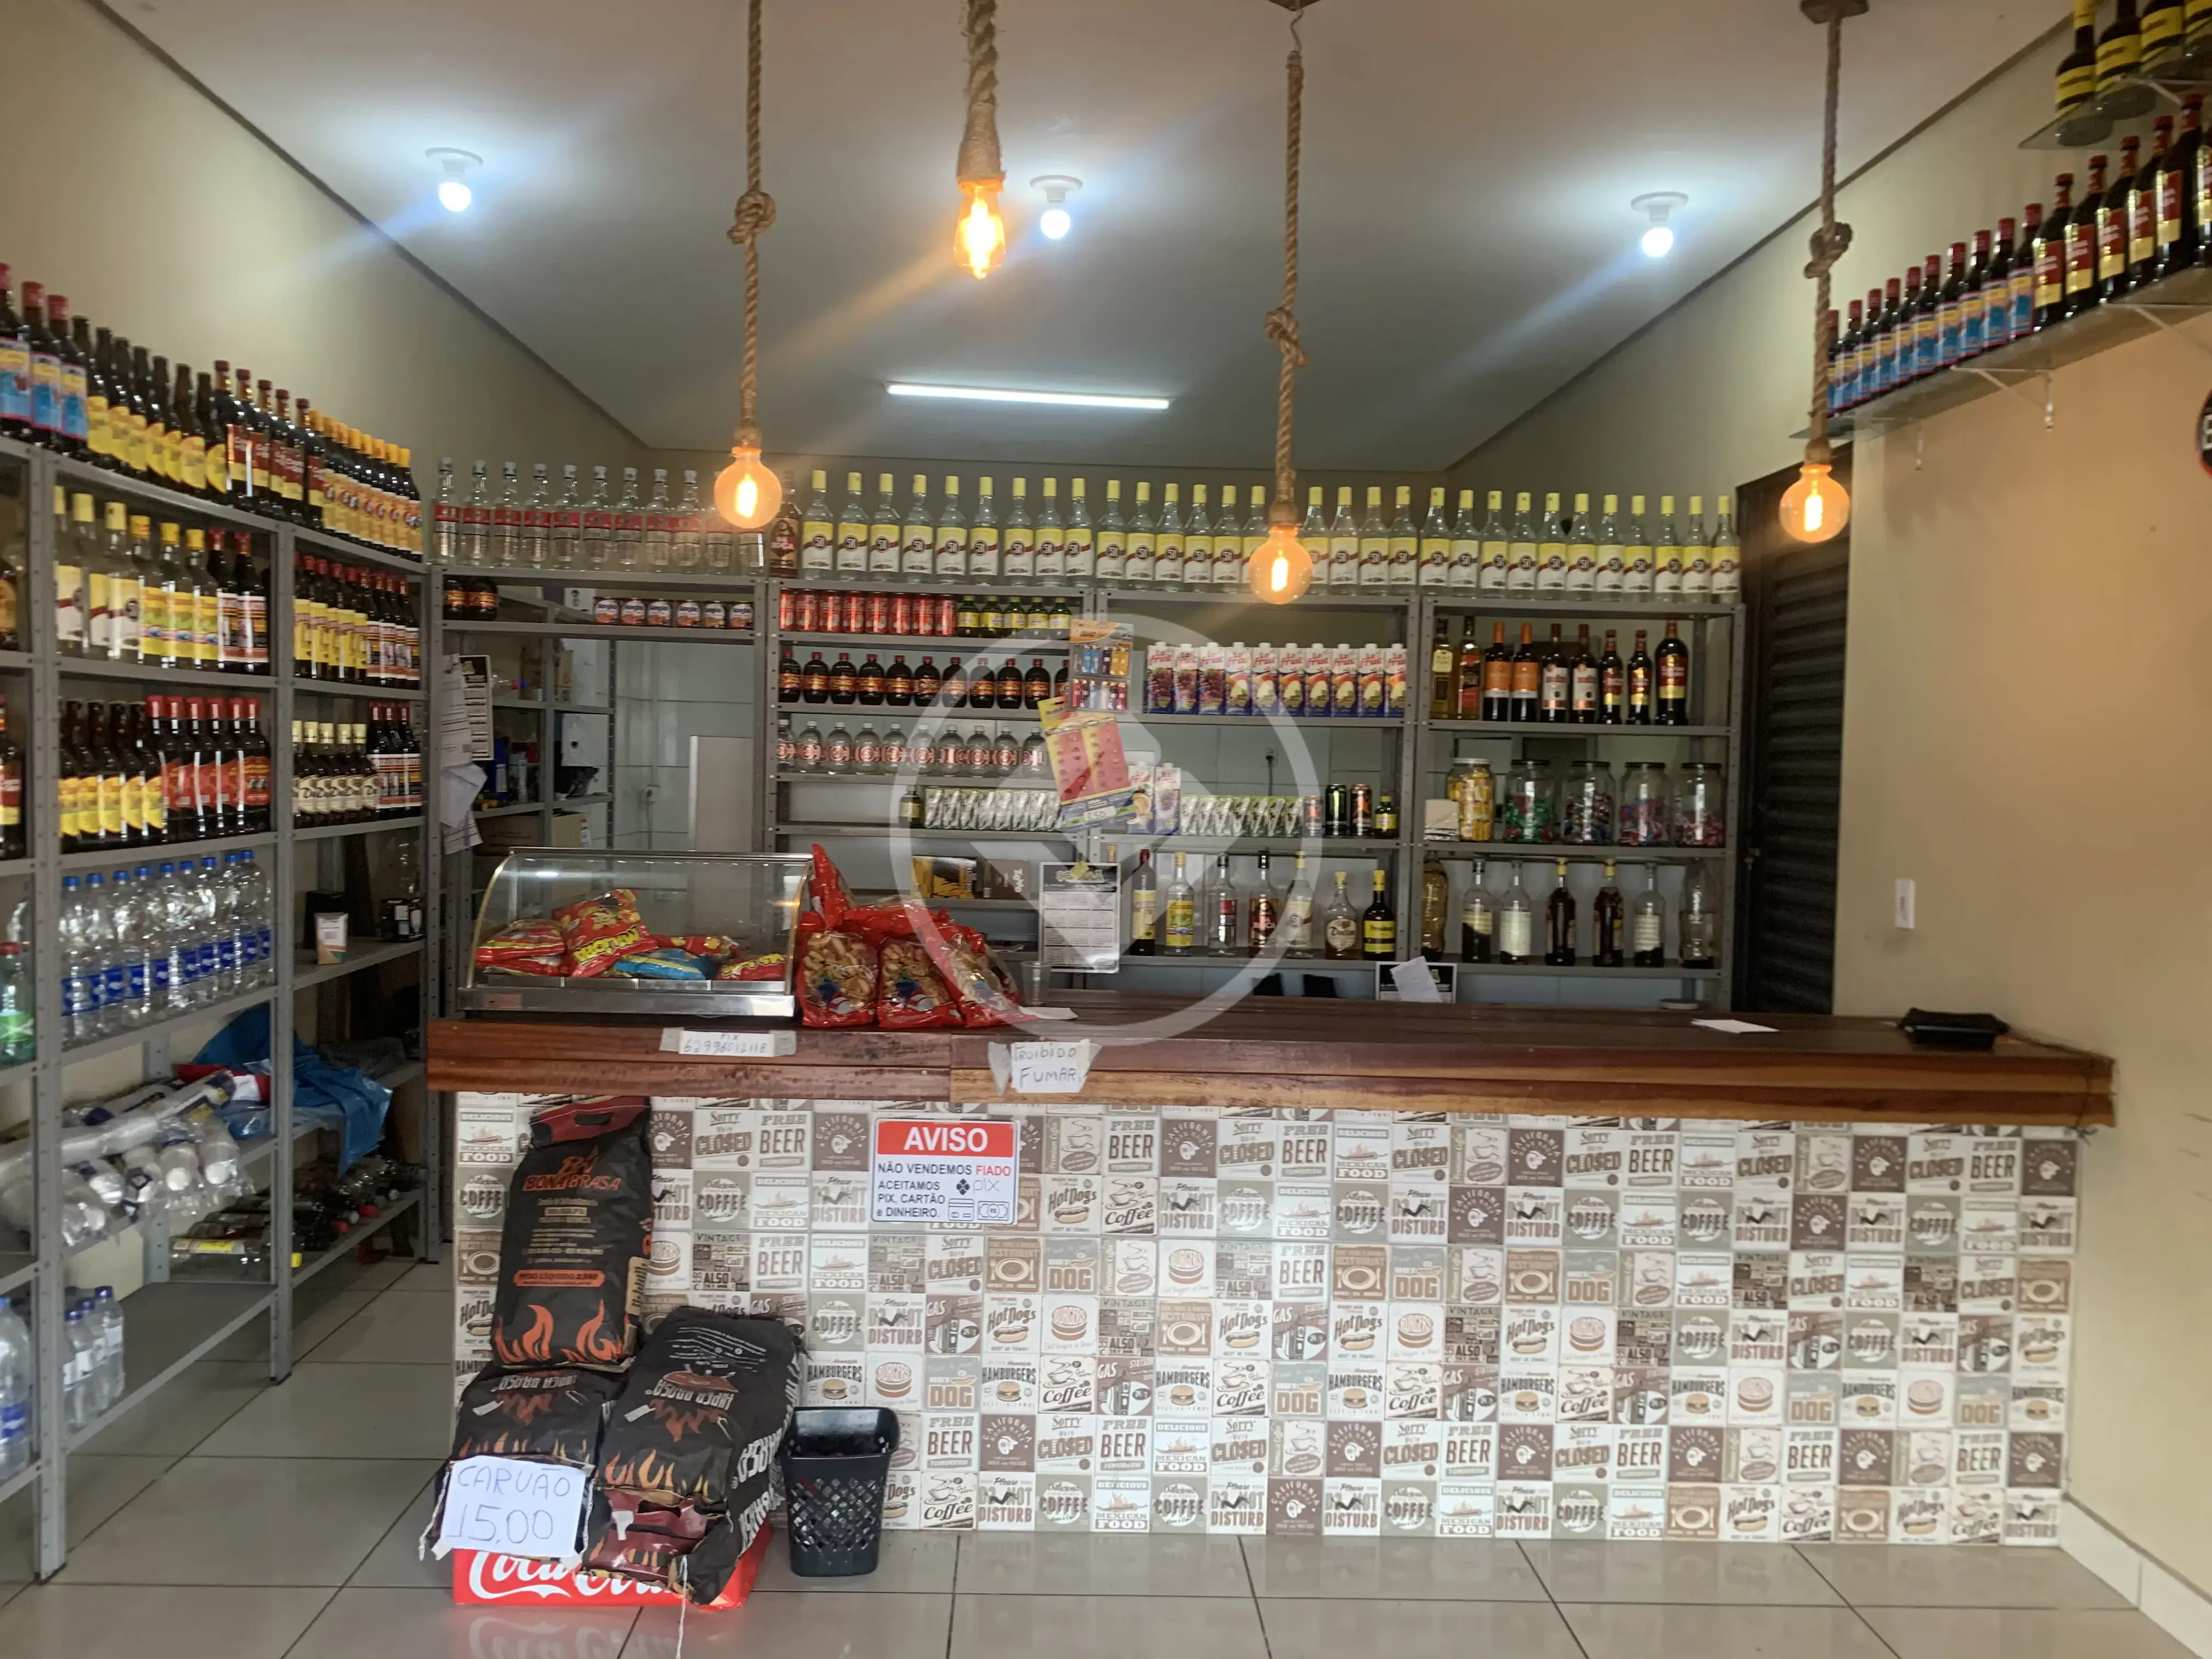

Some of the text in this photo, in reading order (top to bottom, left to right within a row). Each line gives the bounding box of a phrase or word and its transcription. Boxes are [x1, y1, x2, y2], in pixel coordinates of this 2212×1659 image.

[1110, 1118, 1155, 1131] FREE
[1283, 1123, 1328, 1136] FREE
[760, 1128, 804, 1154] BEER
[904, 1127, 988, 1152] AVISO
[1109, 1133, 1153, 1160] BEER
[1282, 1138, 1326, 1165] BEER
[1629, 1147, 1673, 1174] BEER
[878, 1161, 1011, 1176] NÃO VENDEMOS FIADO
[1339, 1169, 1386, 1178] FOOD
[878, 1181, 940, 1190] ACEITAMOS
[974, 1179, 1000, 1194] pix
[696, 1193, 746, 1211] COFFEE
[878, 1193, 945, 1204] PIX, CARTÃO
[886, 1207, 940, 1218] DINHEIRO.
[1105, 1207, 1154, 1227] Coffee
[1160, 1213, 1214, 1229] DISTURB
[1335, 1205, 1384, 1223] COFFEE
[757, 1218, 805, 1227] FOOD
[1391, 1219, 1444, 1235] DISTURB
[1506, 1222, 1559, 1238] DISTURB
[758, 1250, 802, 1276] BEER
[1279, 1259, 1324, 1285] BEER
[815, 1279, 862, 1288] FOOD
[1049, 1268, 1091, 1290] DOG
[1395, 1276, 1437, 1298] DOG
[1568, 1280, 1610, 1302] DOG
[811, 1315, 861, 1333] COFFEE
[868, 1328, 922, 1344] DISTURB
[1098, 1362, 1117, 1379] GAS
[929, 1386, 972, 1407] DOG
[1043, 1386, 1091, 1404] Coffee
[1217, 1390, 1265, 1408] Coffee
[1277, 1392, 1319, 1413] DOG
[929, 1415, 974, 1427] FREE
[928, 1430, 972, 1455] BEER
[1039, 1435, 1093, 1458] CLOSED
[1101, 1432, 1145, 1458] BEER
[1212, 1438, 1266, 1462] CLOSED
[1446, 1438, 1490, 1464] BEER
[1384, 1441, 1438, 1465] CLOSED
[1617, 1441, 1661, 1466] BEER
[1787, 1444, 1831, 1469] BEER
[1158, 1462, 1205, 1471] FOOD
[924, 1503, 973, 1521] Coffee
[1039, 1496, 1087, 1513] COFFEE
[1154, 1498, 1203, 1515] COFFEE
[1384, 1502, 1432, 1518] COFFEE
[1555, 1504, 1604, 1521] COFFEE
[978, 1506, 1032, 1522] DISTURB
[1210, 1511, 1263, 1526] DISTURB
[1324, 1513, 1377, 1528] DISTURB
[1496, 1515, 1549, 1531] DISTURB
[446, 1504, 553, 1544] 15,00
[1098, 1520, 1145, 1528] FOOD
[1443, 1525, 1489, 1534] FOOD
